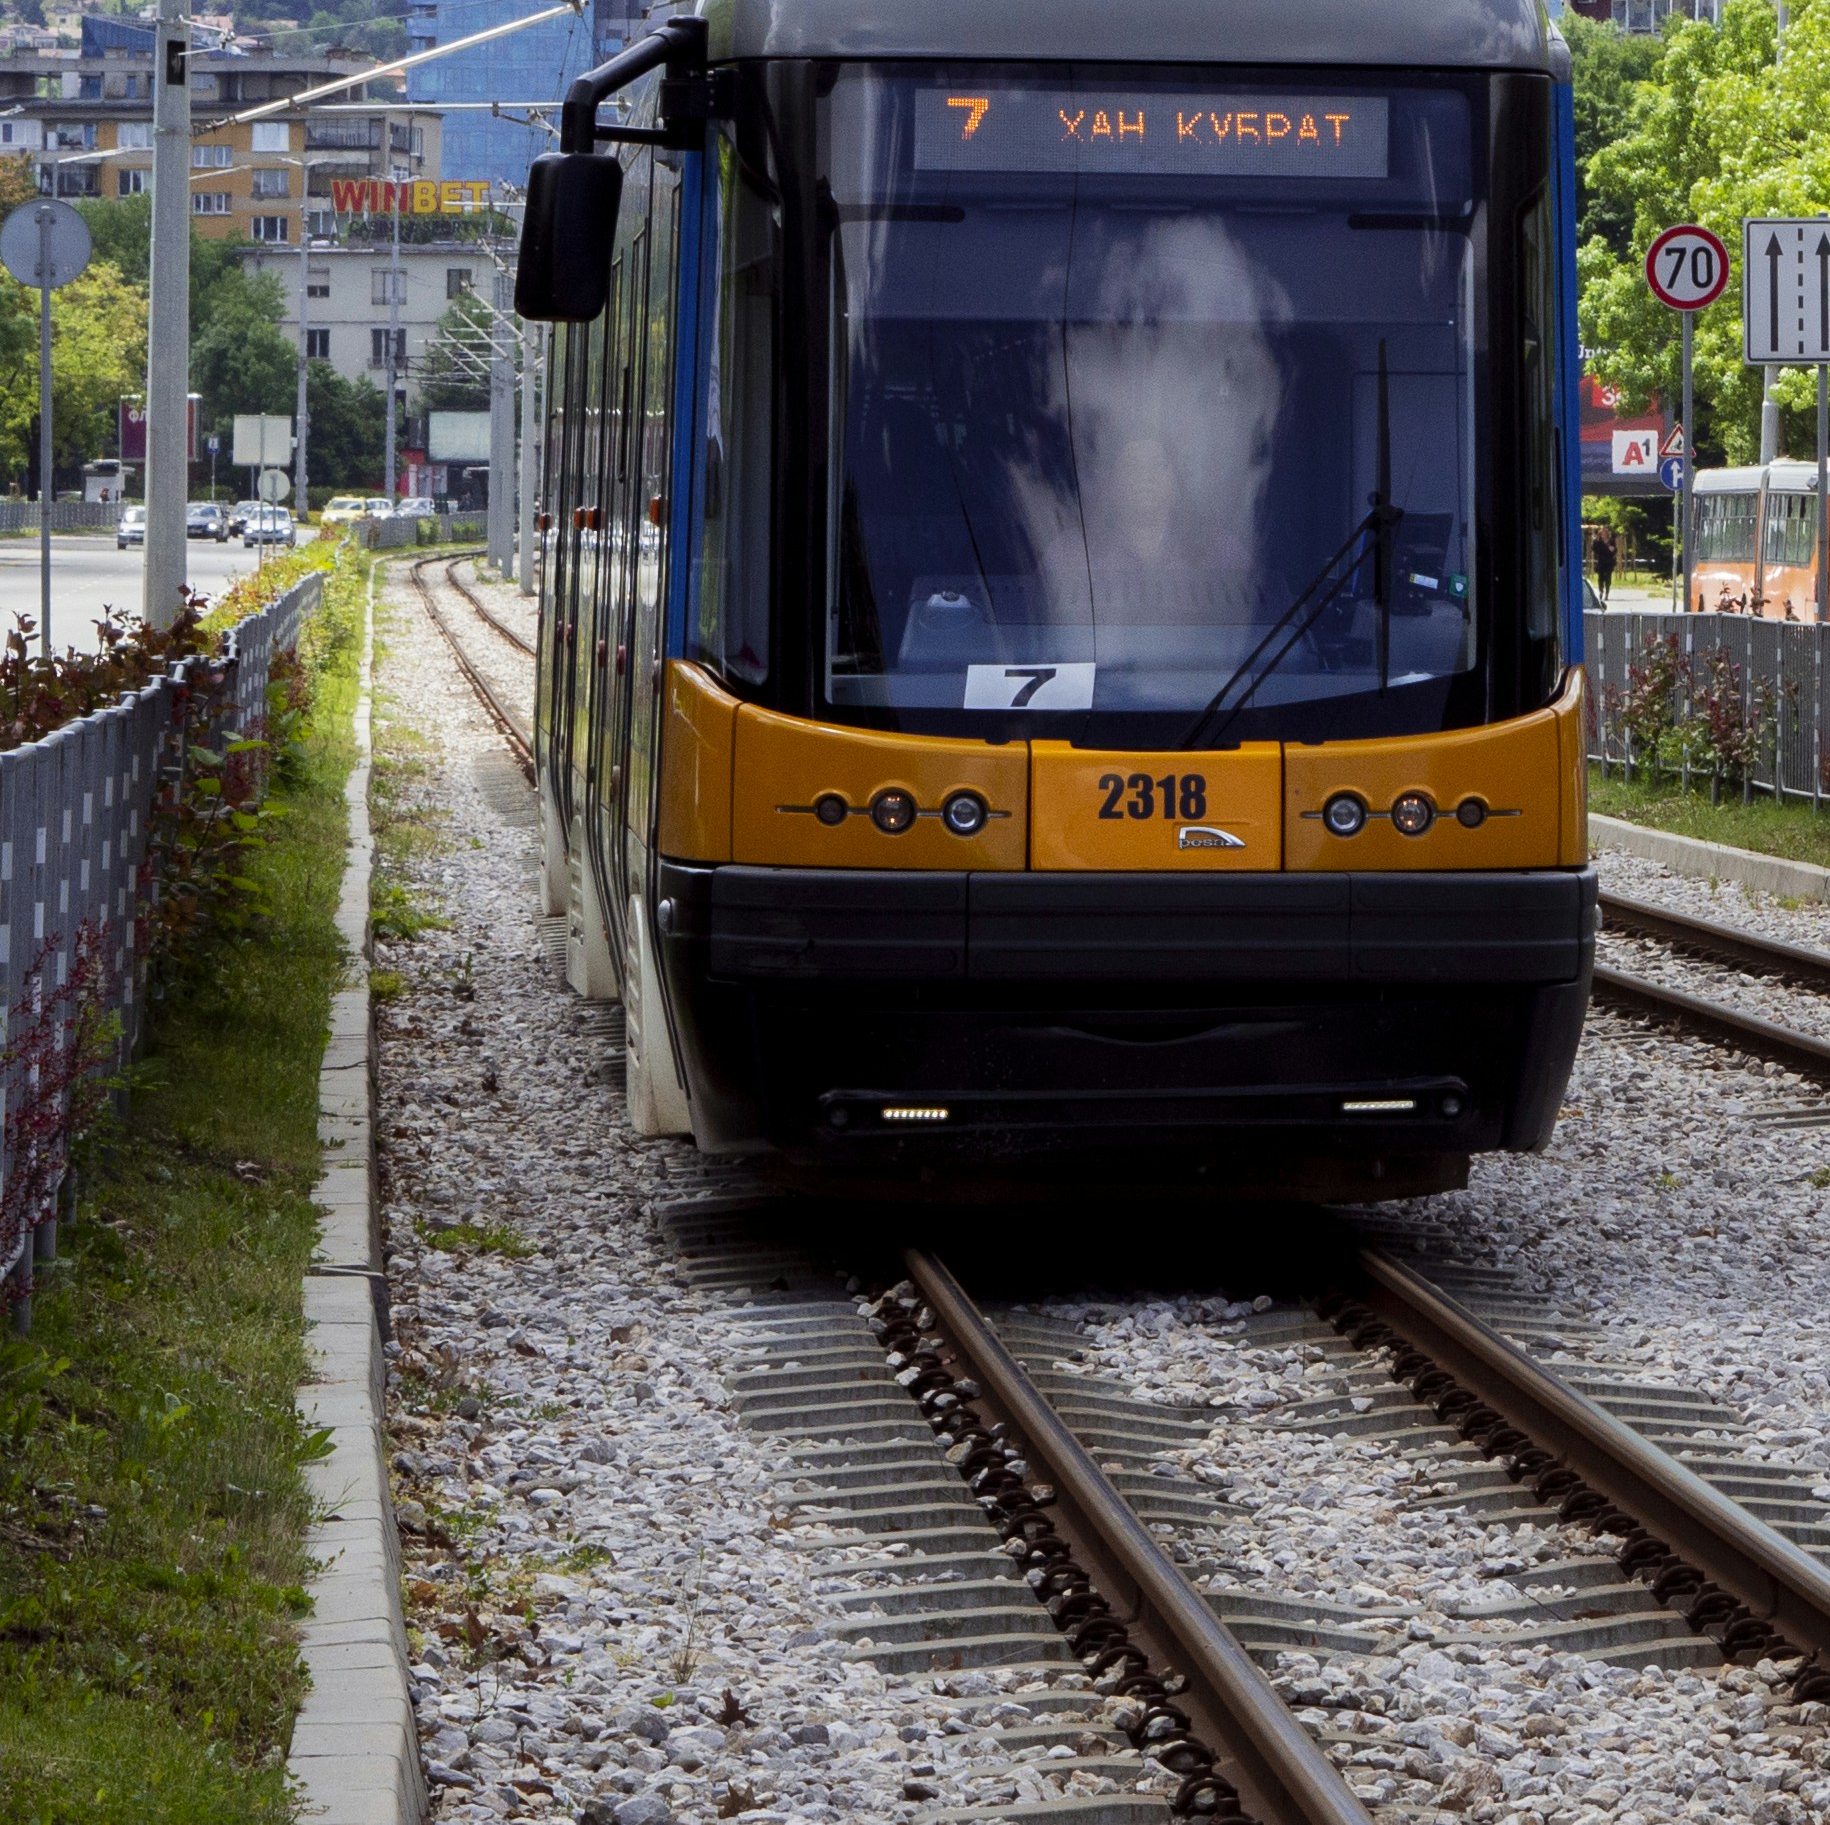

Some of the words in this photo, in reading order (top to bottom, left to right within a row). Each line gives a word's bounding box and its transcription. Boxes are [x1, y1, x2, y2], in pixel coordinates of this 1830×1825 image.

[946, 97, 989, 141] 7
[331, 179, 490, 215] WINBET
[1664, 245, 1713, 290] 70
[1622, 438, 1651, 466] A1
[1003, 668, 1057, 707] 7
[1098, 773, 1207, 820] 2318
